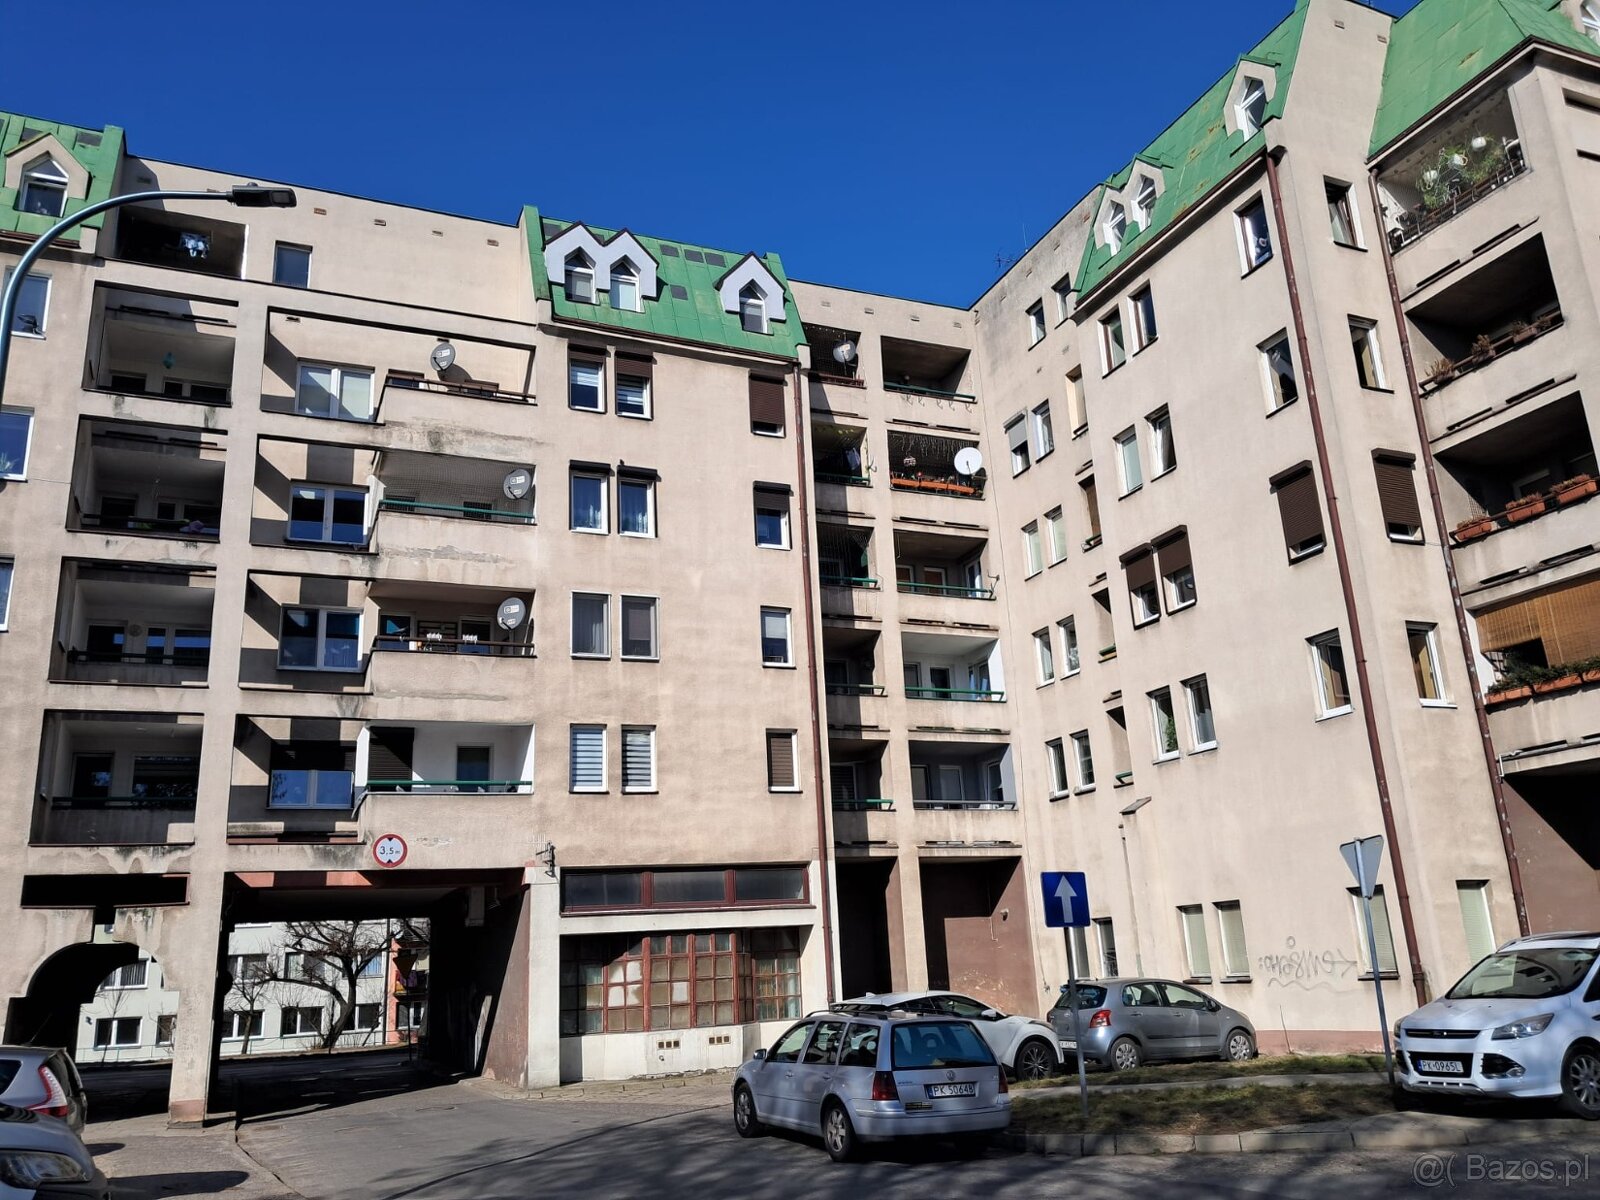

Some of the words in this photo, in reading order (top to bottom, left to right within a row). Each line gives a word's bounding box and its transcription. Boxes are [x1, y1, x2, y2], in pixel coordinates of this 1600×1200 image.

[1422, 1061, 1433, 1070] PK
[1435, 1061, 1461, 1072] 0965L
[934, 1086, 946, 1096] PK
